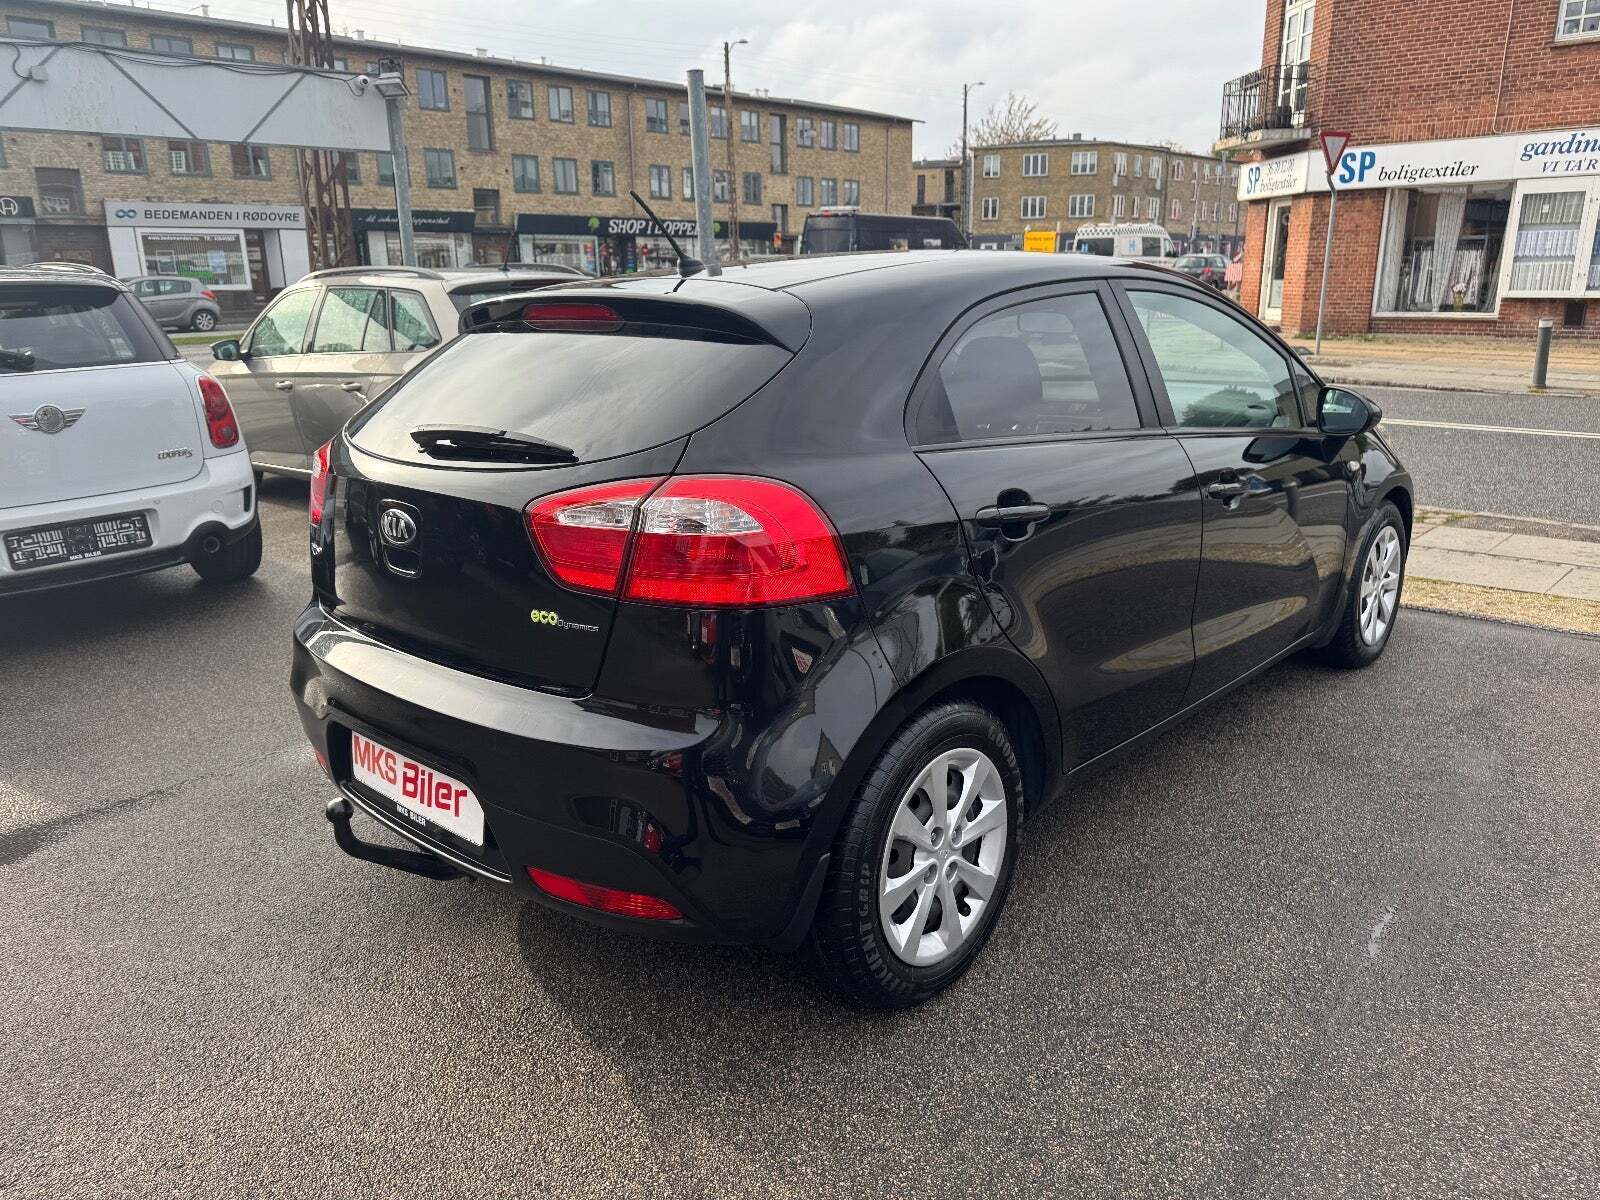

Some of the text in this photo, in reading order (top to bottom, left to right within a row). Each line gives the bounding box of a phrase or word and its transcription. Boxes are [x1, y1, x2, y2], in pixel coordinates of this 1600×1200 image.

[1520, 132, 1600, 162] gardin
[1340, 151, 1480, 184] SP boligtextiler
[1543, 161, 1560, 173] VI
[1247, 166, 1298, 196] SP boligtextiler
[144, 209, 300, 223] BEDEMANDEN I RØDOVRE
[608, 219, 646, 234] SHOP
[383, 514, 409, 540] KIA
[353, 734, 468, 817] MKS Biler
[396, 803, 427, 827] MKS BILER
